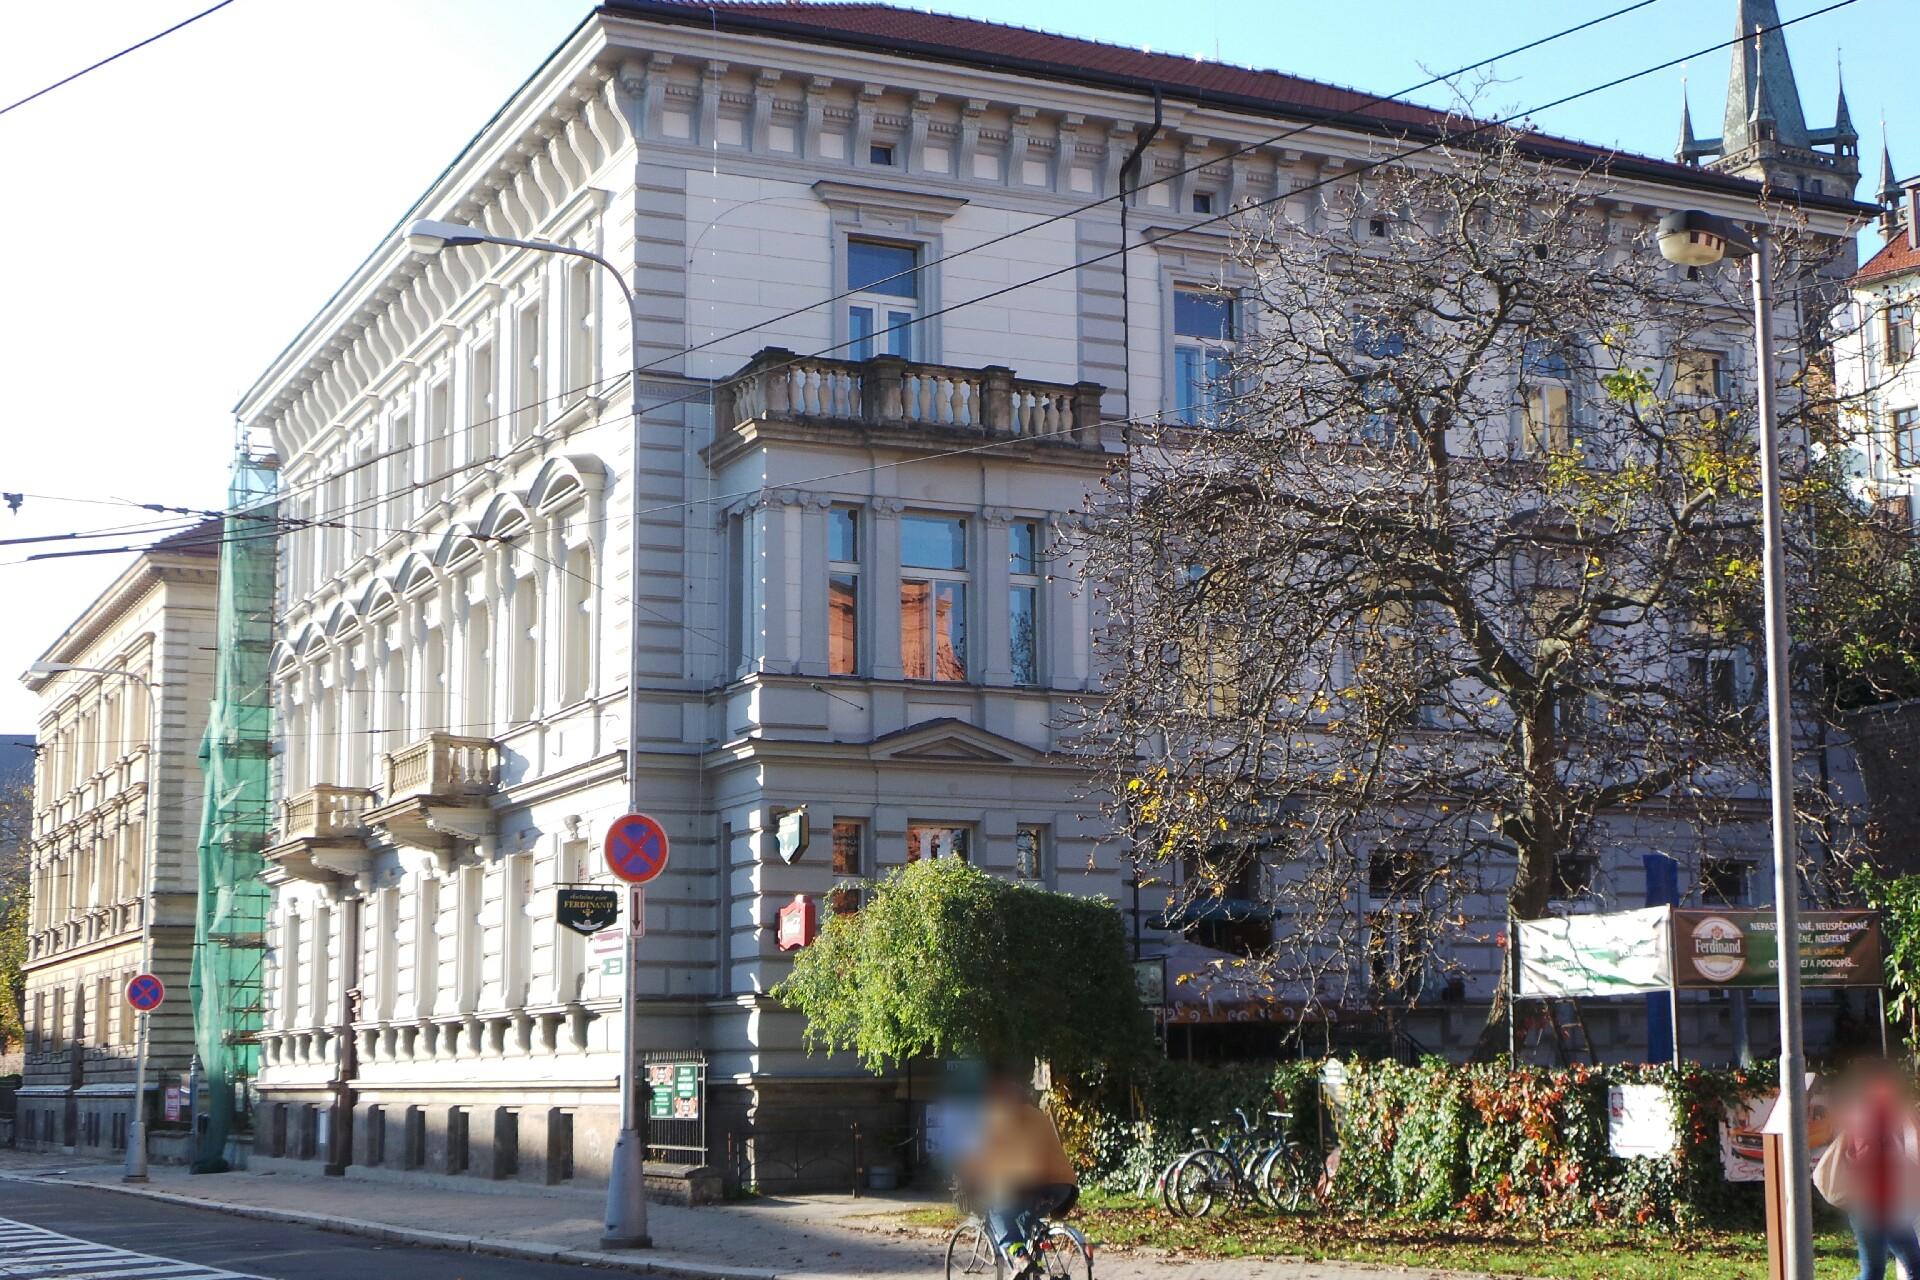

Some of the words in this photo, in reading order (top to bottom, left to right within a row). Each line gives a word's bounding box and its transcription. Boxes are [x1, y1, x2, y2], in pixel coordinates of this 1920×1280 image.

[564, 900, 613, 908] FERDINAND
[1695, 939, 1741, 954] Ferdinand
[1809, 960, 1815, 968] A
